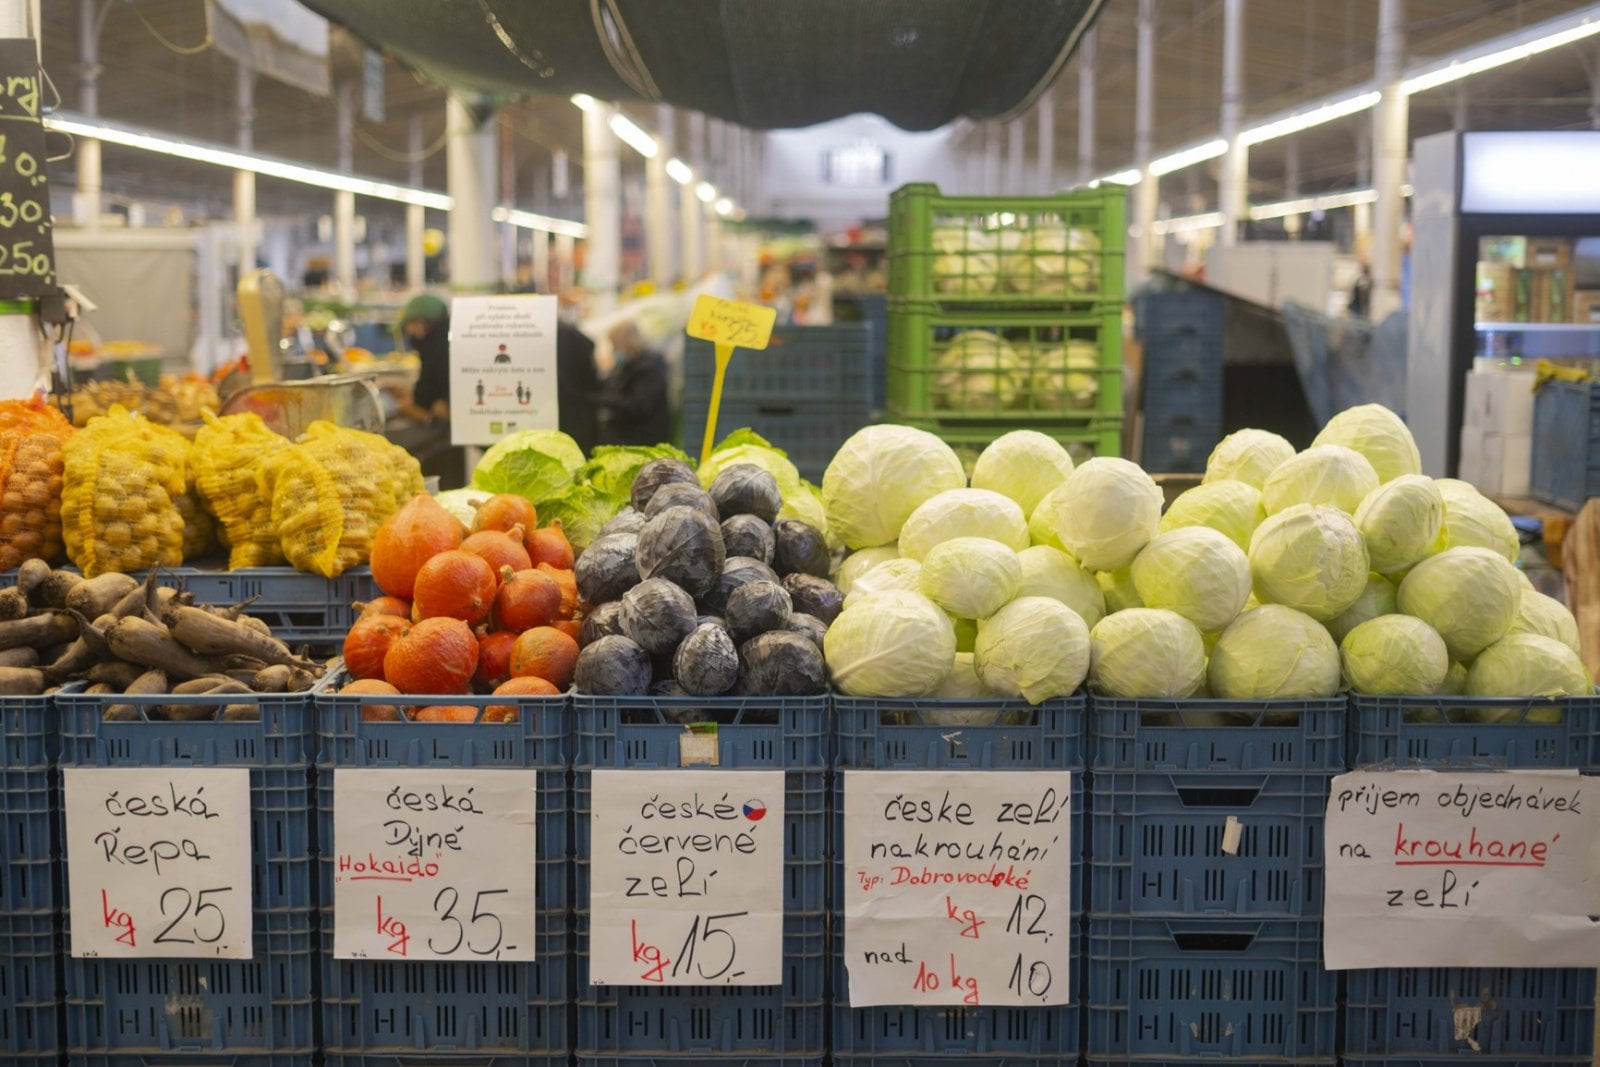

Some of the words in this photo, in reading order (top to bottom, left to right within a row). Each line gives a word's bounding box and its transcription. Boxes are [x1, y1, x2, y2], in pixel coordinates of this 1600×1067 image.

[0, 76, 39, 117] ry
[105, 782, 219, 818] česká
[386, 784, 484, 814] česká
[641, 792, 738, 821] české
[997, 787, 1069, 825] zelí
[1338, 783, 1420, 815] příjem
[1437, 783, 1582, 817] objednávek
[94, 826, 211, 876] Řepa
[618, 824, 757, 854] červené
[1339, 843, 1372, 859] na
[1394, 822, 1560, 862] krouhané
[625, 856, 719, 898] zelí
[857, 871, 884, 891] Typ:
[1386, 869, 1480, 909] zelí
[101, 888, 137, 947] kg
[377, 895, 411, 957] kg
[946, 895, 986, 940] kg
[631, 918, 671, 983] kg
[864, 941, 914, 965] nad
[913, 961, 940, 993] 10
[950, 953, 980, 1005] kg
